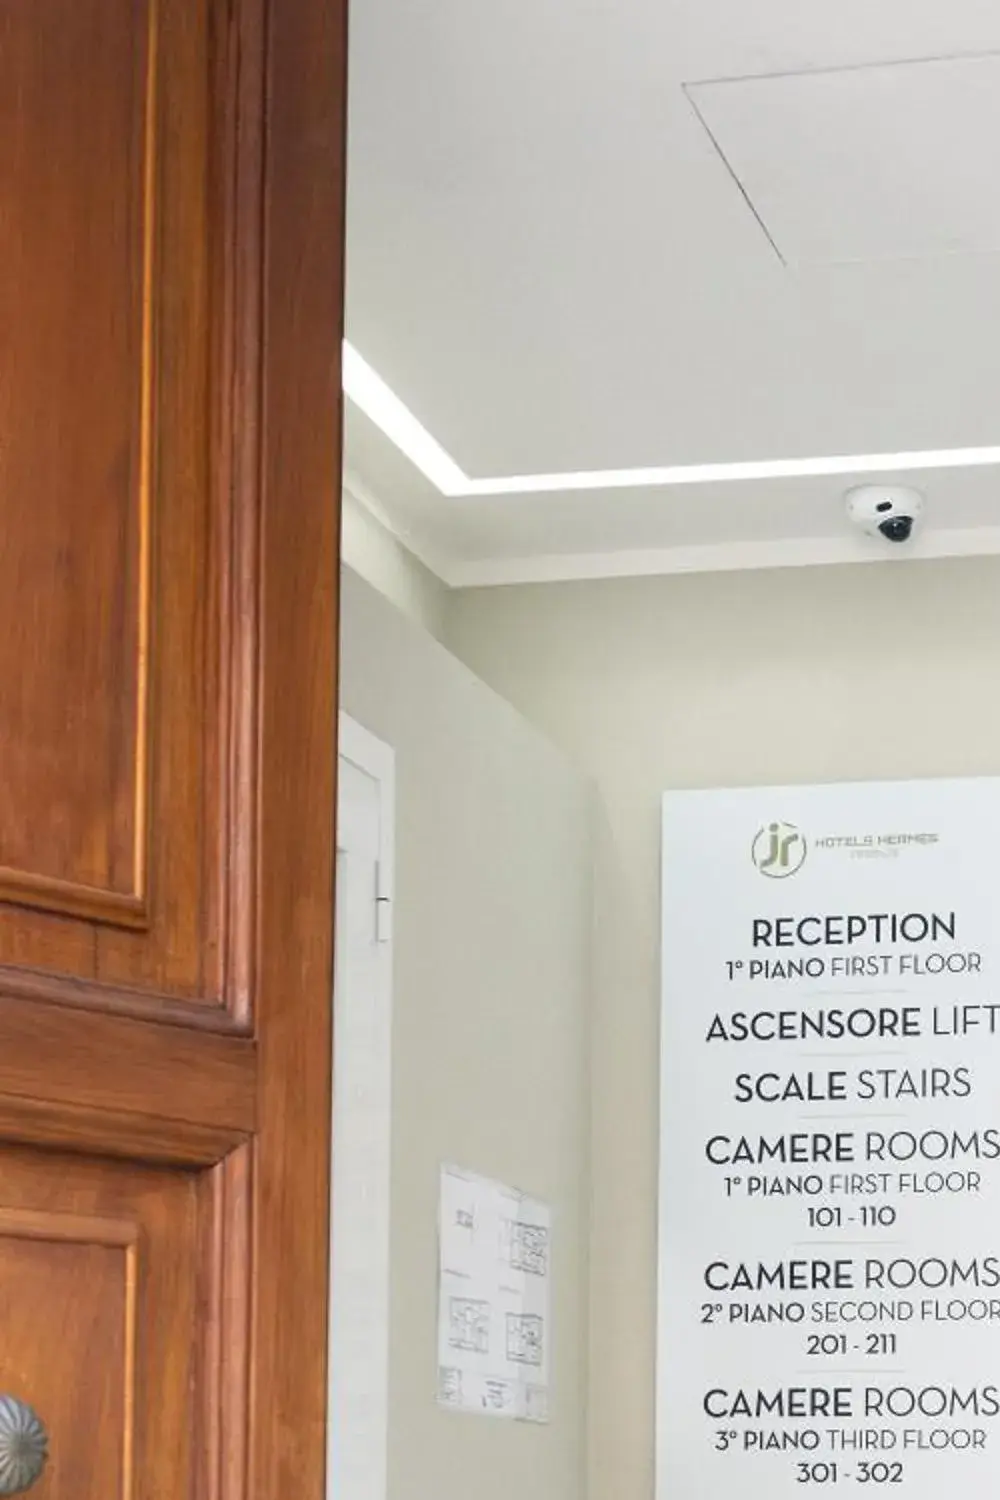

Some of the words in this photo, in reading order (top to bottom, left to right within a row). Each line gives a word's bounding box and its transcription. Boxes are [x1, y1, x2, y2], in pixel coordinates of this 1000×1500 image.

[814, 835, 874, 848] HOTELS
[876, 832, 940, 847] HERMES
[751, 911, 956, 949] RECEPTION
[748, 956, 826, 981] PIANO
[830, 954, 894, 978] FIRST
[898, 951, 982, 976] FLOOR
[704, 1006, 923, 1044] ASCENSORE
[732, 1070, 849, 1104] SCALE
[855, 1066, 973, 1102] STAIRS
[703, 1131, 856, 1166] CAMERE
[746, 1174, 826, 1198] PIANO
[828, 1172, 894, 1196] FIRST
[897, 1171, 982, 1195] FLOOR
[703, 1258, 857, 1293] CAMERE
[728, 1301, 805, 1325] PIANO
[810, 1299, 915, 1325] SECOND
[702, 1386, 853, 1420] CAMERE
[742, 1427, 822, 1453] PIANO
[824, 1426, 898, 1451] THIRD
[902, 1426, 988, 1451] FLOOR
